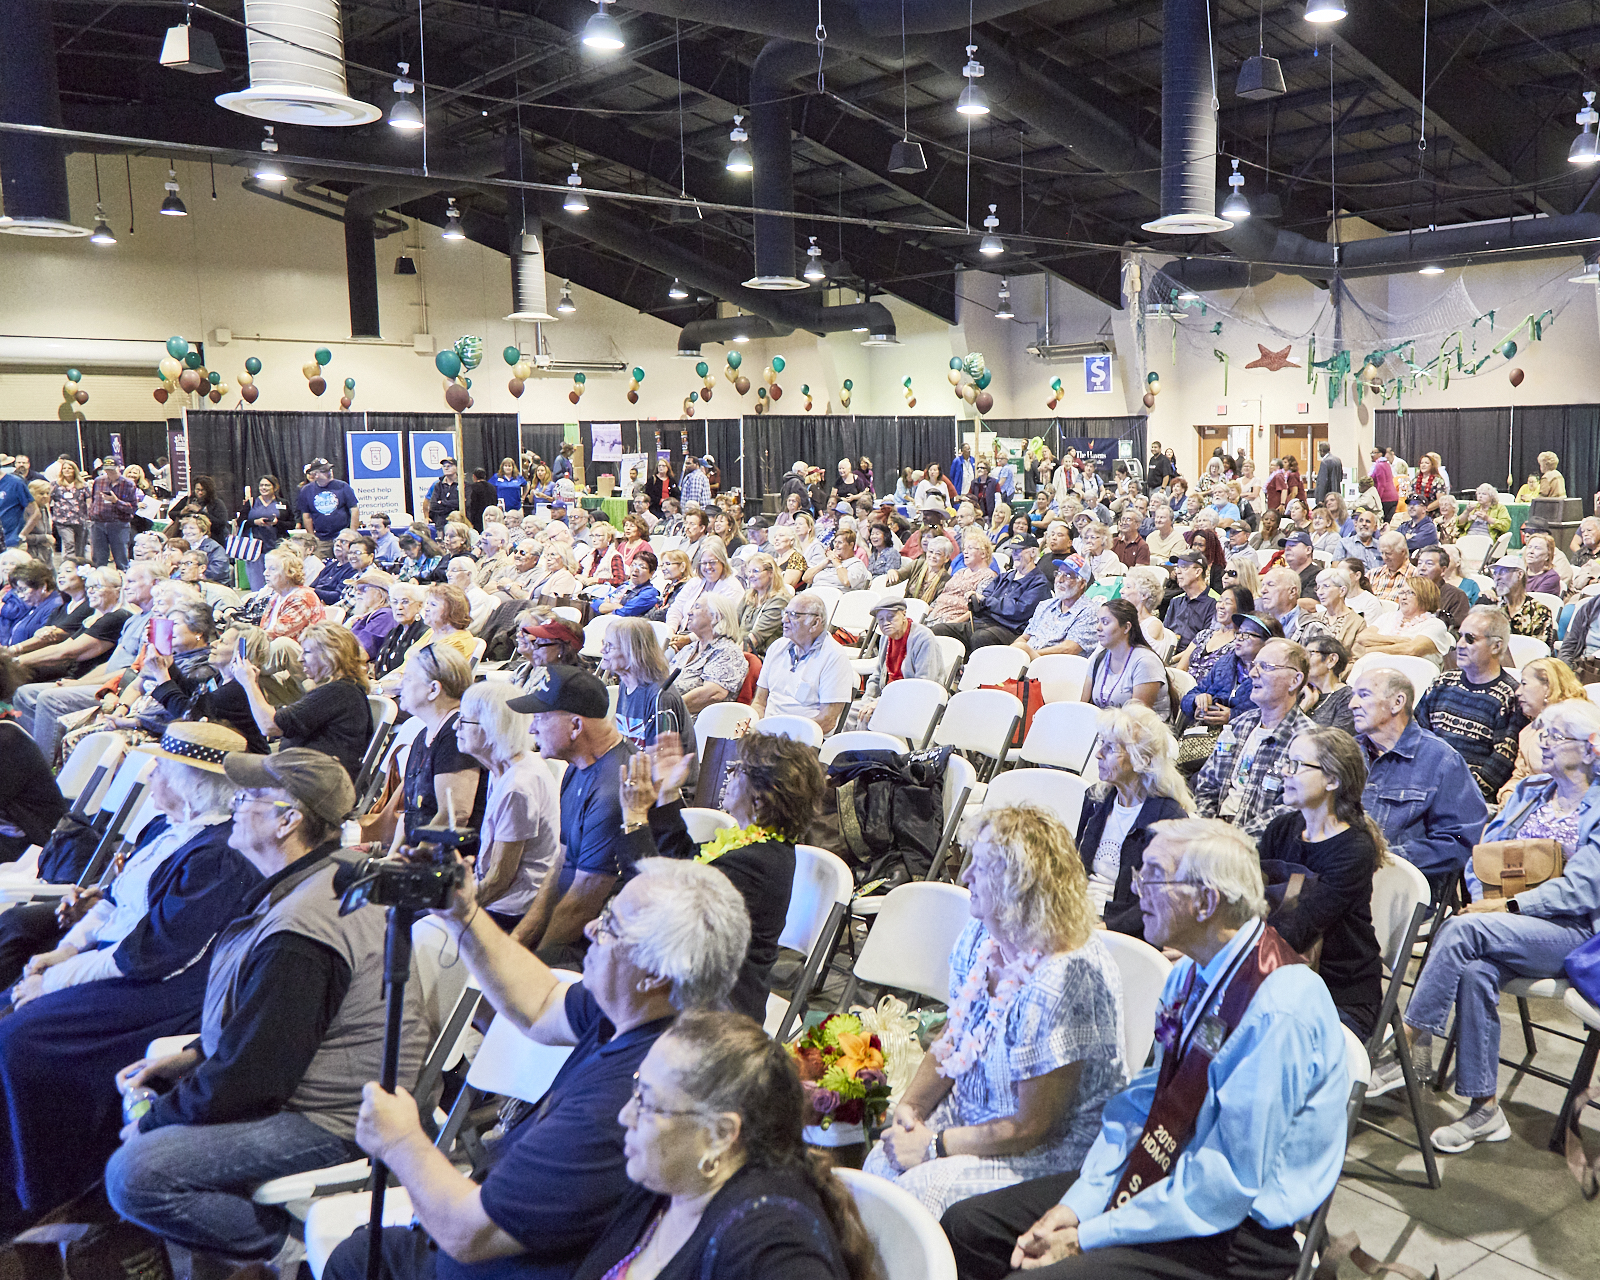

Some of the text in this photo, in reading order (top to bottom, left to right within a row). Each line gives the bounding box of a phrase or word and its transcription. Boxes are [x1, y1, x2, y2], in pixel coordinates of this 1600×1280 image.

[1076, 450, 1086, 458] The
[358, 501, 399, 509] prescription
[1153, 1124, 1178, 1154] 2019
[1141, 1131, 1171, 1173] HDMG
